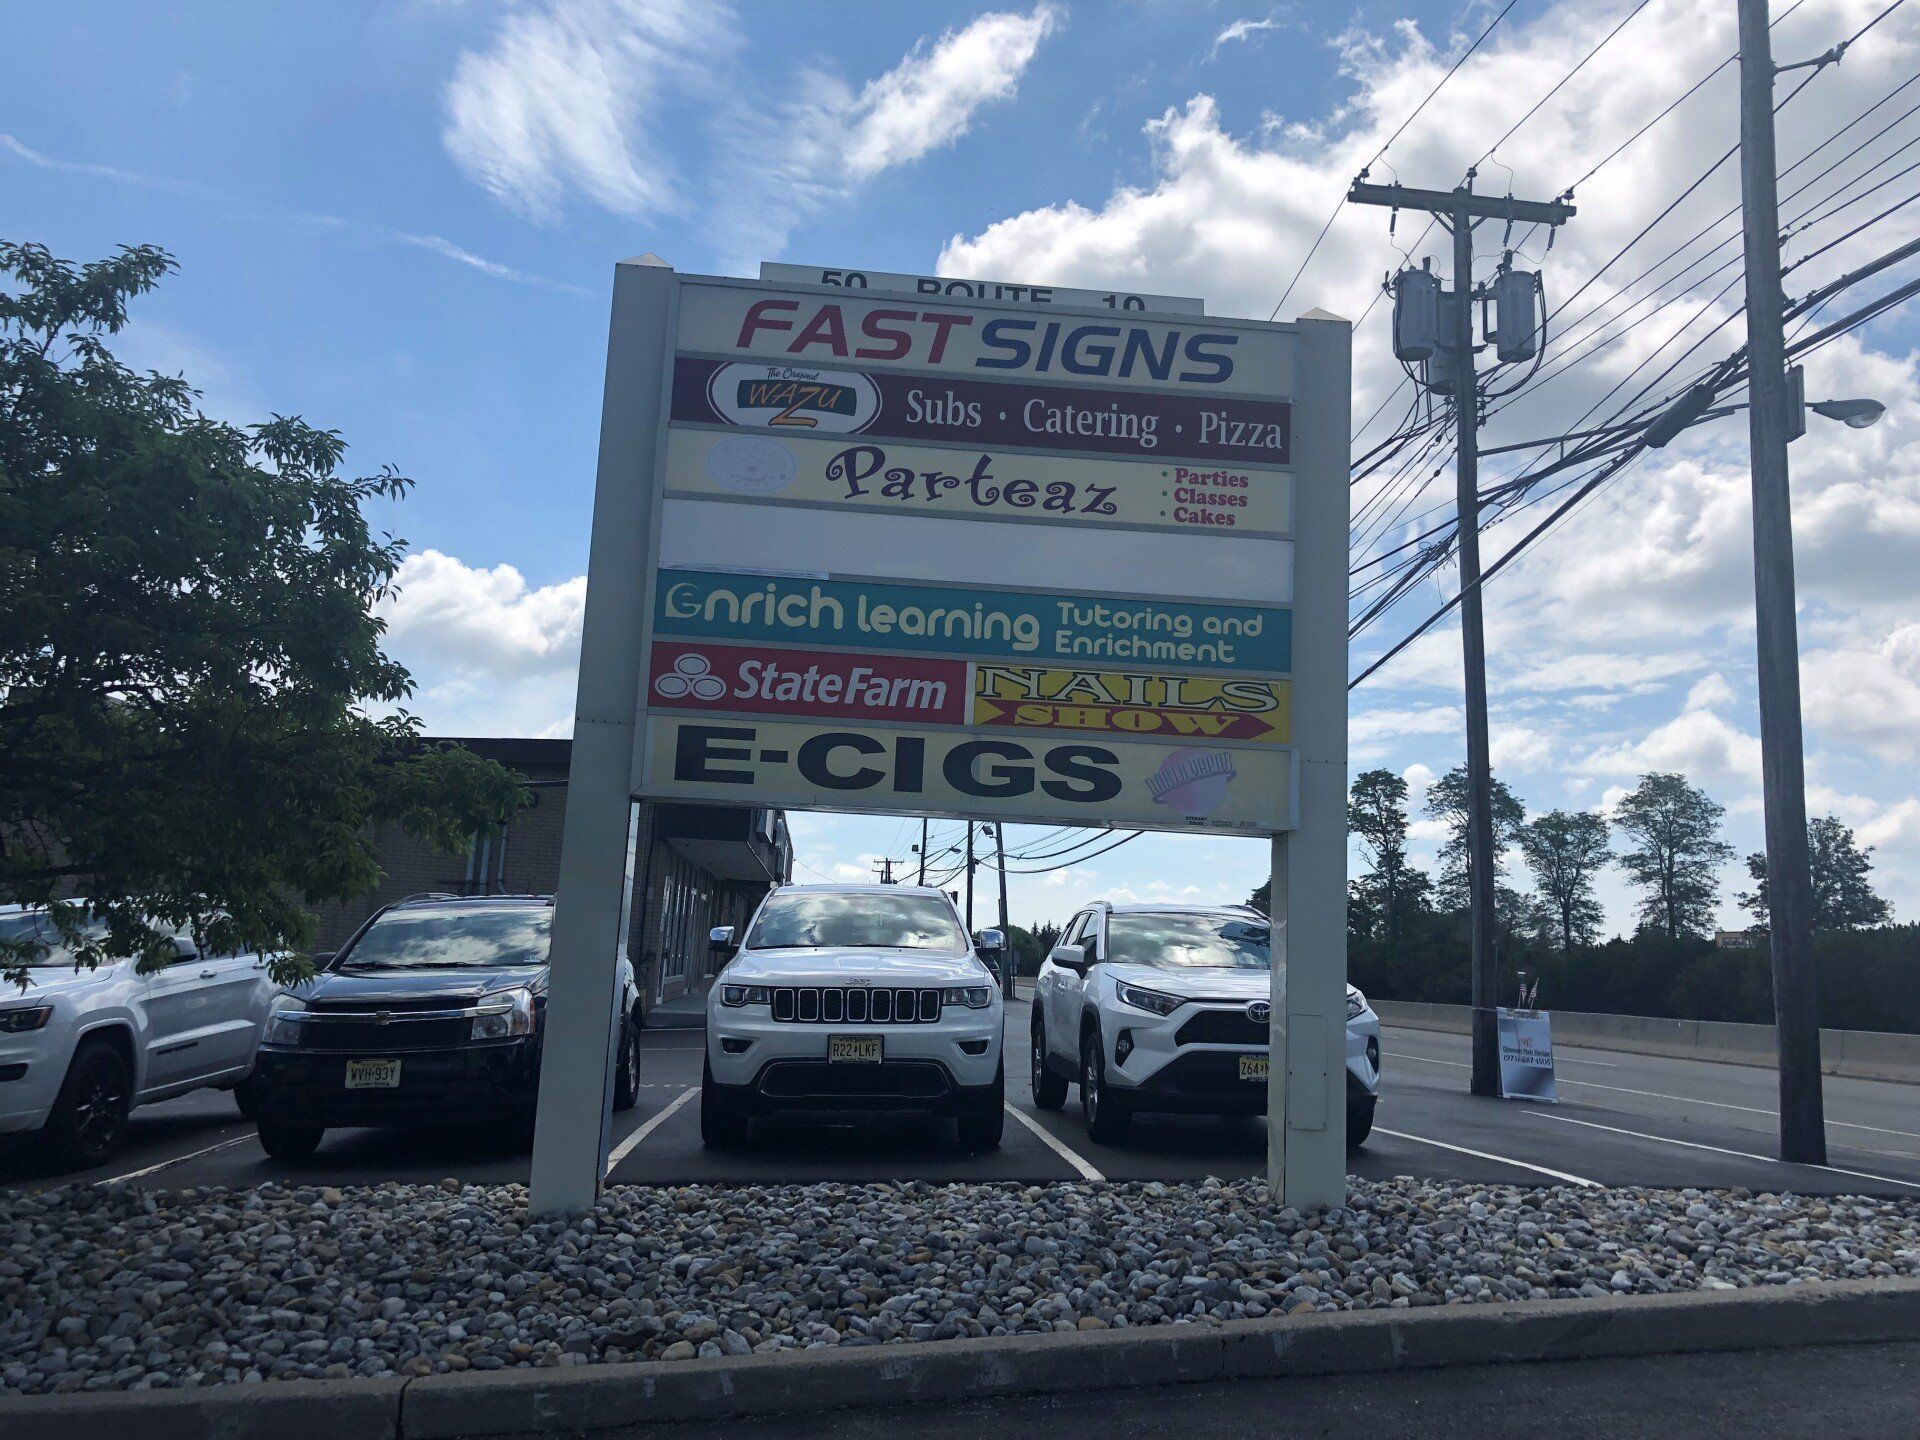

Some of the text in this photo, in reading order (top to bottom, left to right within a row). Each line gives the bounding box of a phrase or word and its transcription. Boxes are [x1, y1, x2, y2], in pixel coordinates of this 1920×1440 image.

[917, 278, 1053, 303] ROUTE
[766, 366, 820, 382] The Original
[749, 383, 842, 428] WAZU
[906, 389, 1283, 449] Subs Catering Pizza
[825, 446, 1118, 516] Parteaz
[1174, 467, 1249, 488] Parties
[1173, 487, 1248, 507] Classes
[1173, 506, 1236, 526] Cakes
[857, 594, 1040, 652] learning
[1056, 601, 1263, 638] Tutoring and
[1055, 629, 1236, 663] Enrichment
[976, 665, 1280, 714] NAILS
[1014, 704, 1240, 735] SHOW
[674, 724, 1123, 803] E-CIGS
